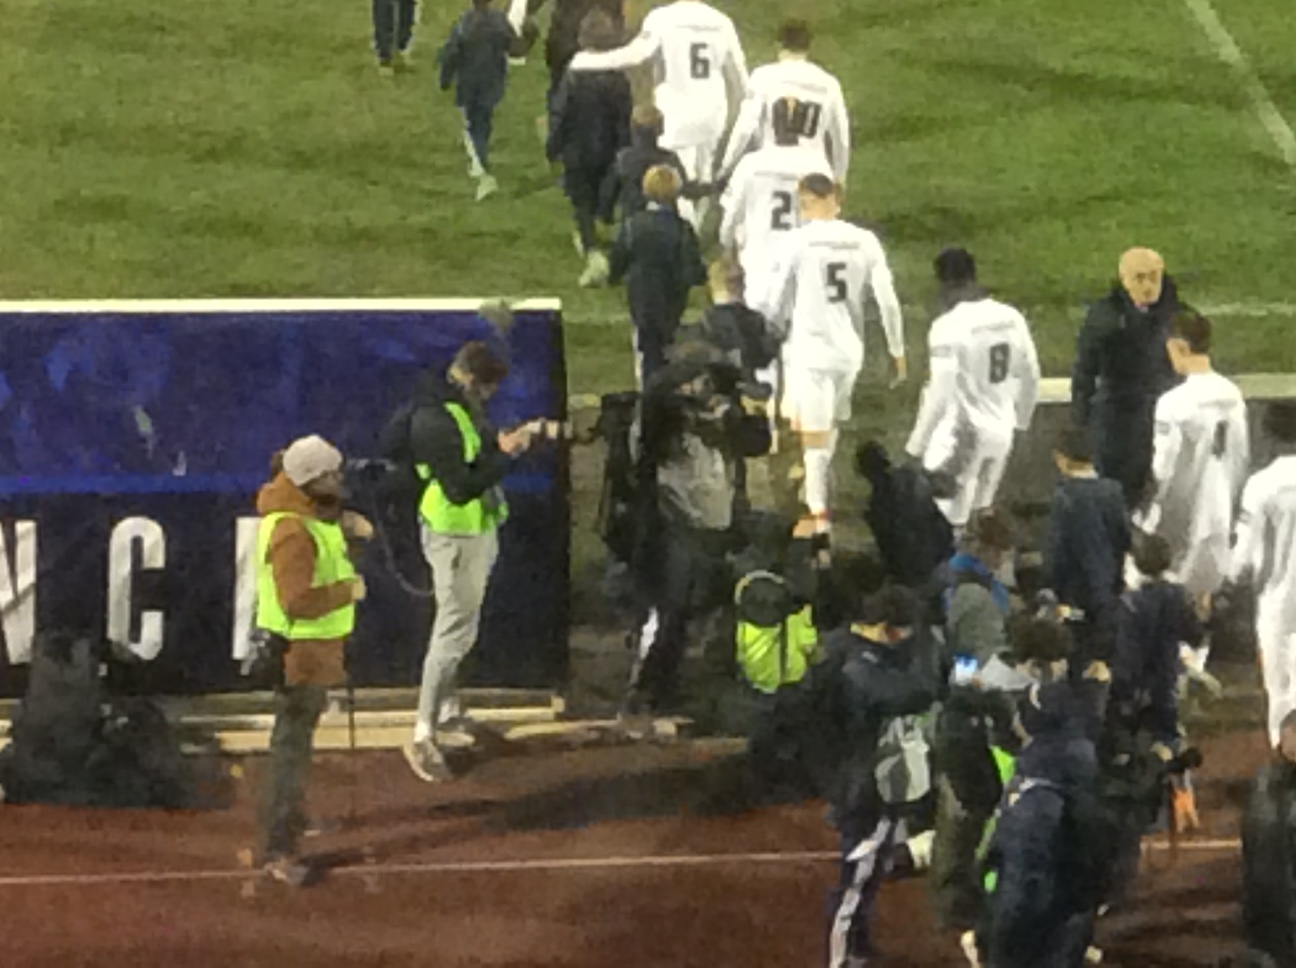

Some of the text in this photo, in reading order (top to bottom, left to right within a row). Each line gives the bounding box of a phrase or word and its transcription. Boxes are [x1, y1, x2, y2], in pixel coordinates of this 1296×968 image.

[690, 43, 711, 79] 6
[771, 190, 792, 231] 2
[827, 261, 847, 303] 5
[988, 342, 1010, 384] 8
